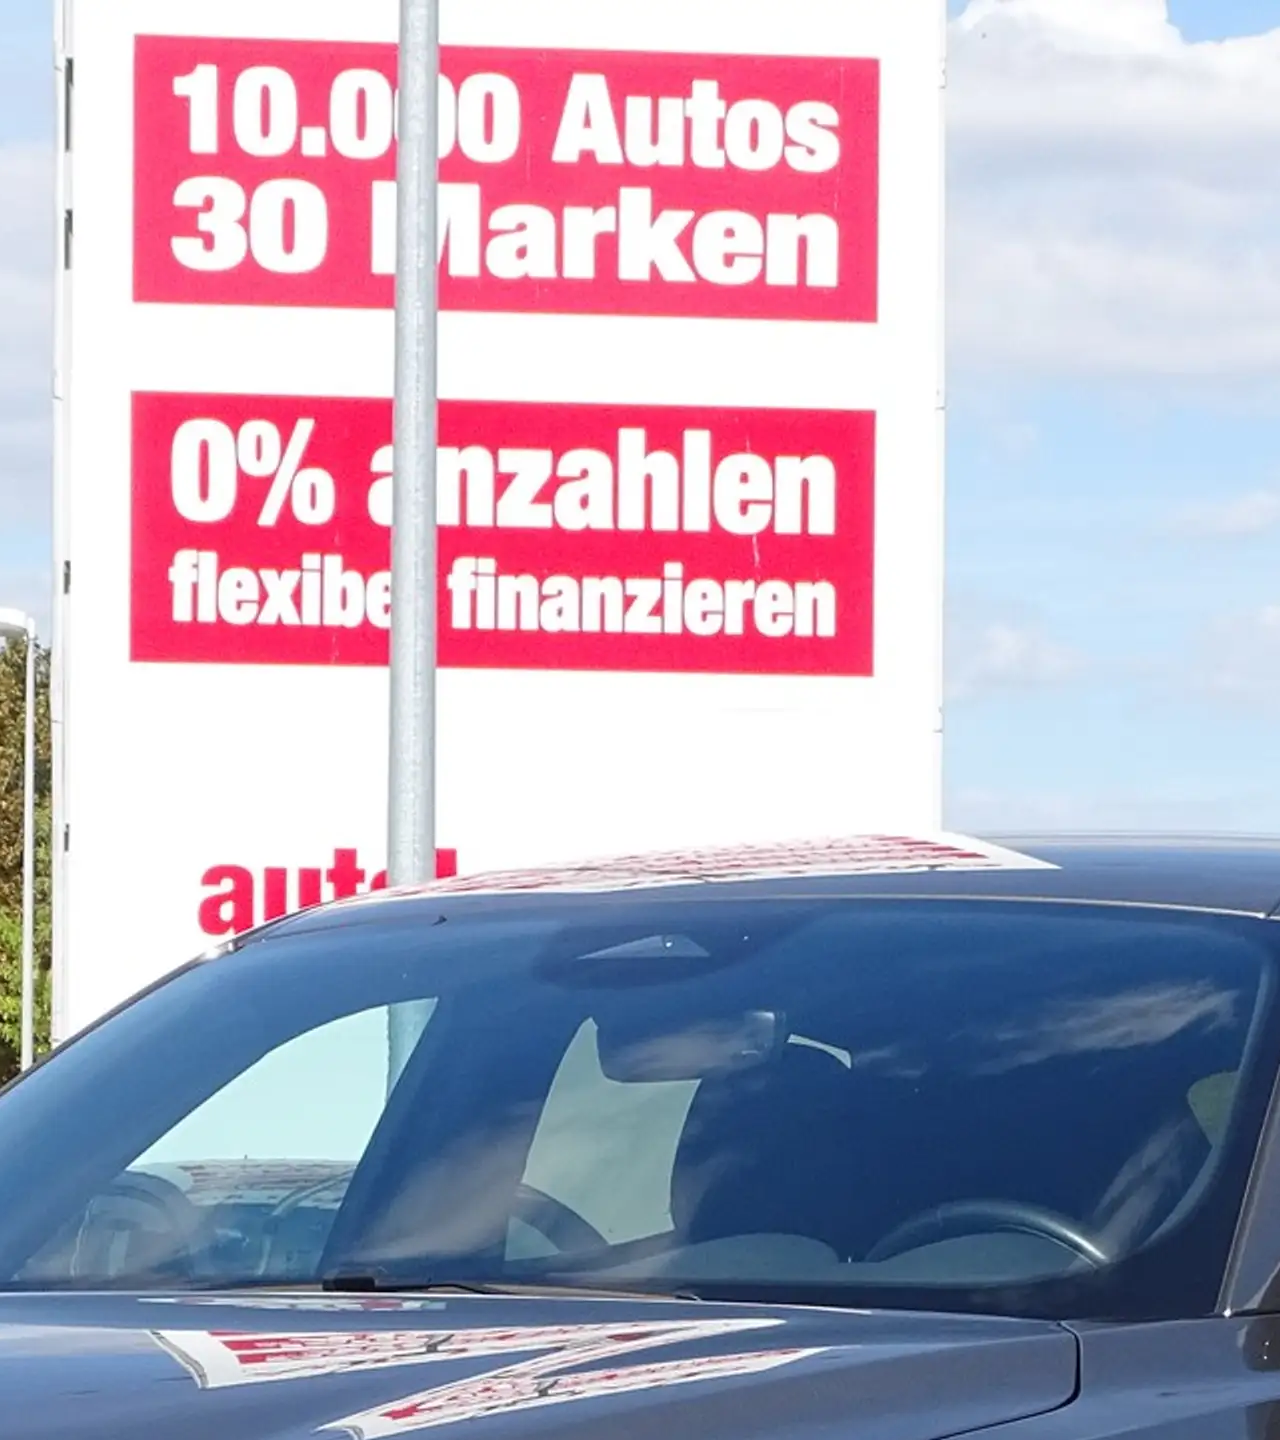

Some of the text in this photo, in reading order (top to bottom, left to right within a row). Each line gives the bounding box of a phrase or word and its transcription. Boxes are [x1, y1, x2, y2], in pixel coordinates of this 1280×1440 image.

[552, 73, 840, 173] Autos
[171, 175, 839, 288] 30 Marken
[171, 418, 335, 527] 0%
[169, 549, 836, 637] flexibe finanzieren
